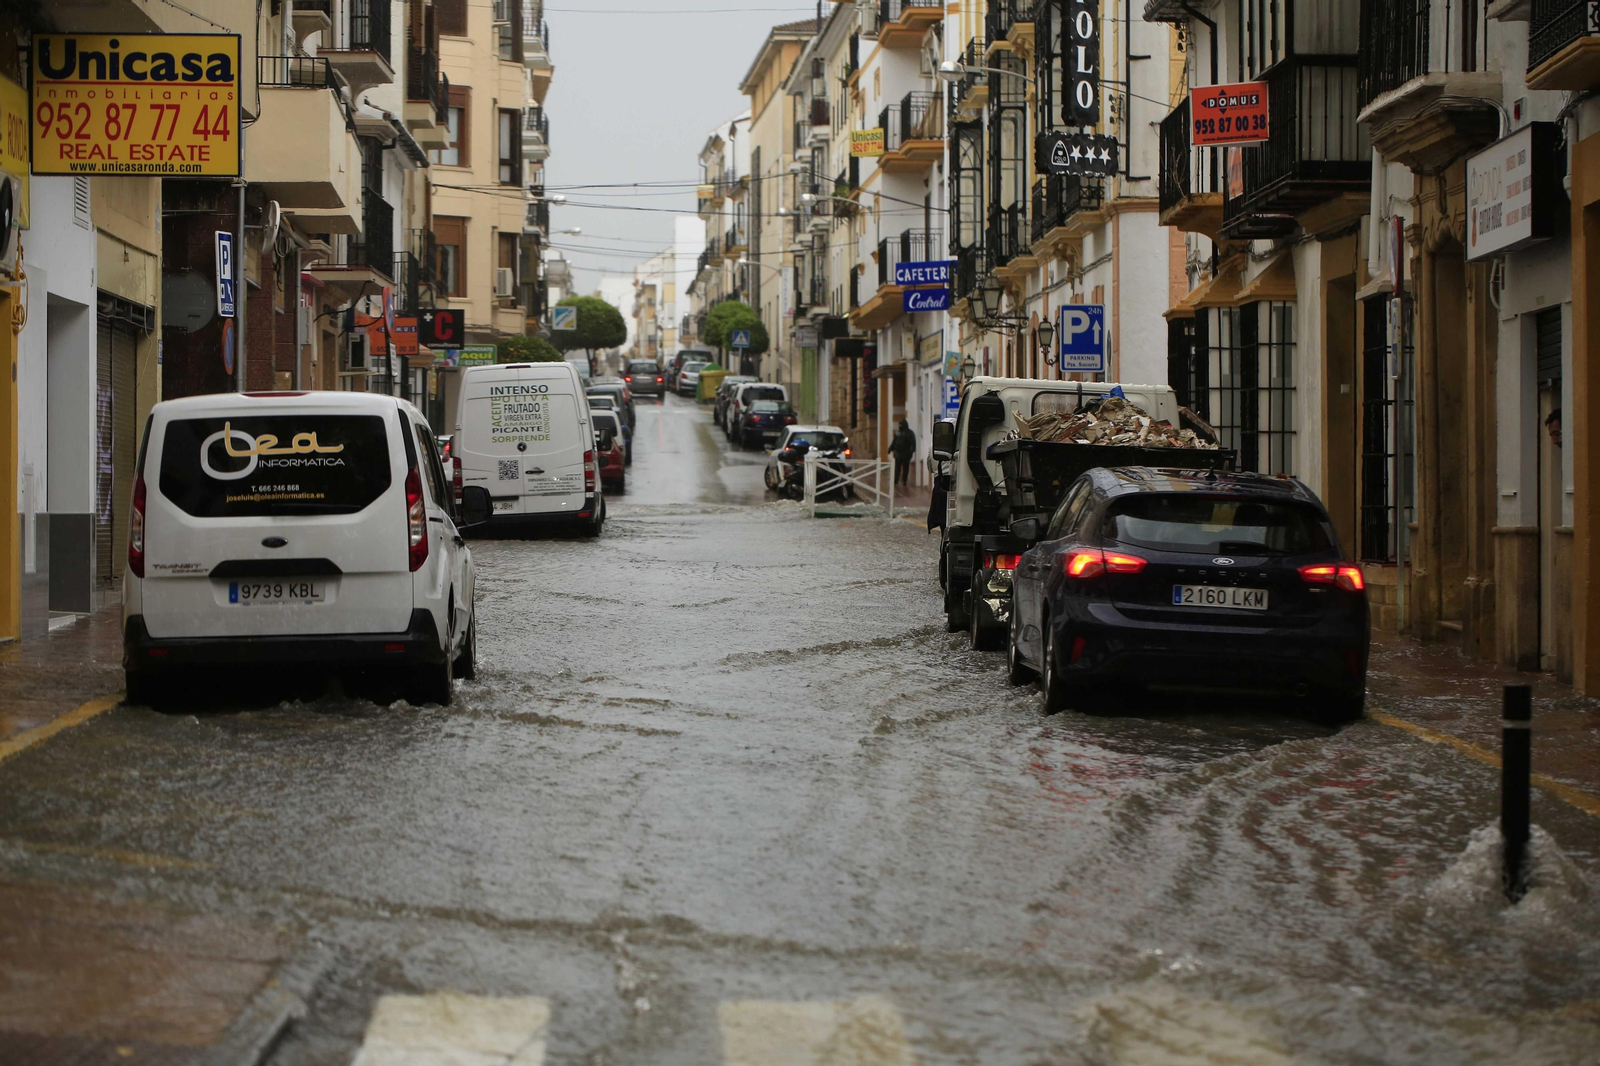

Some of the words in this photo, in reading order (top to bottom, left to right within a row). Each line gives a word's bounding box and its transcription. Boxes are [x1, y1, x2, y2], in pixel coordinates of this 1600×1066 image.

[37, 37, 234, 82] Unicasa
[1075, 0, 1094, 109] OLO
[36, 88, 233, 101] inmobiliarias
[1209, 95, 1257, 108] DOMUS
[36, 101, 91, 141] 952
[104, 102, 137, 141] 87
[149, 103, 180, 141] 77
[193, 104, 230, 142] 44
[1195, 118, 1216, 135] 952
[1219, 117, 1232, 133] 87
[1235, 115, 1249, 131] 00
[1252, 113, 1266, 130] 38
[852, 131, 883, 143] Unicasa
[59, 143, 118, 160] REAL
[129, 144, 210, 161] ESTATE
[70, 160, 202, 174] www.unicasaronda.com
[222, 245, 229, 275] P
[896, 266, 950, 282] CAFETERI
[908, 292, 946, 309] Central
[1088, 307, 1102, 315] 24h
[1063, 309, 1091, 345] P
[490, 384, 549, 396] INTENSO
[502, 394, 550, 403] OLIVA
[491, 395, 502, 428] ACEITE
[503, 402, 540, 413] FRUTADO
[504, 414, 524, 422] VIRGEN
[525, 413, 542, 421] EXTRA
[493, 426, 543, 434] PICANTE
[492, 434, 551, 443] SORPRENDE
[259, 457, 346, 469] INFORMATICA
[226, 492, 325, 503] joseluis@oleainformatica.es
[241, 584, 283, 599] 9739
[288, 583, 320, 598] KBL
[1184, 588, 1226, 605] 2160
[1232, 590, 1264, 607] LKM
